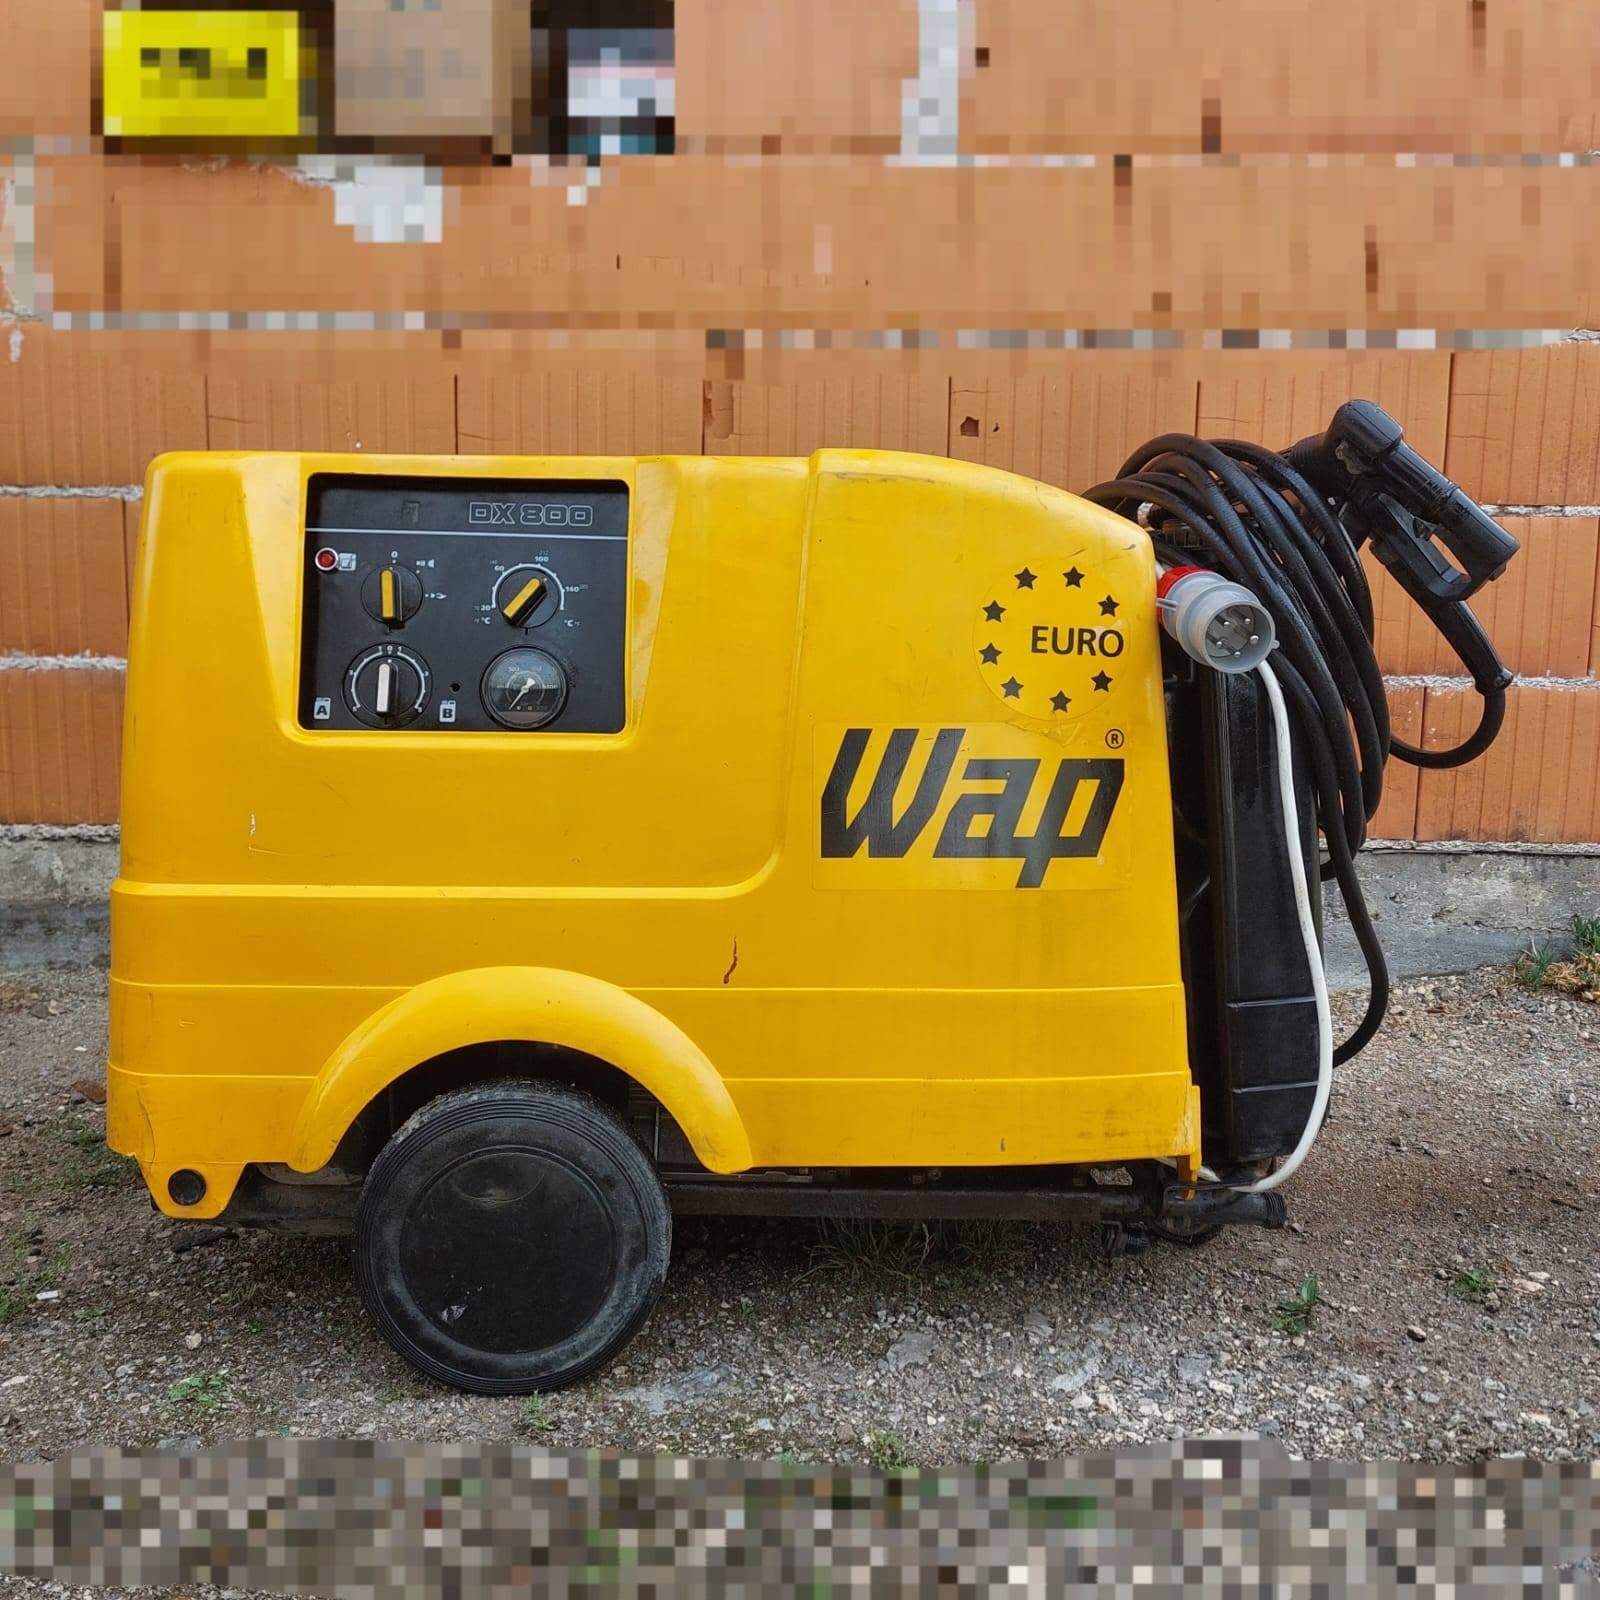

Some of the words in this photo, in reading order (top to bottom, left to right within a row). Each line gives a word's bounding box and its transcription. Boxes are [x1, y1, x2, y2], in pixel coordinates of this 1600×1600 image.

[469, 502, 515, 524] DX
[520, 504, 593, 526] 800
[1030, 625, 1124, 658] EURO
[316, 705, 328, 716] A
[442, 708, 453, 718] B
[821, 728, 1125, 888] Wap
